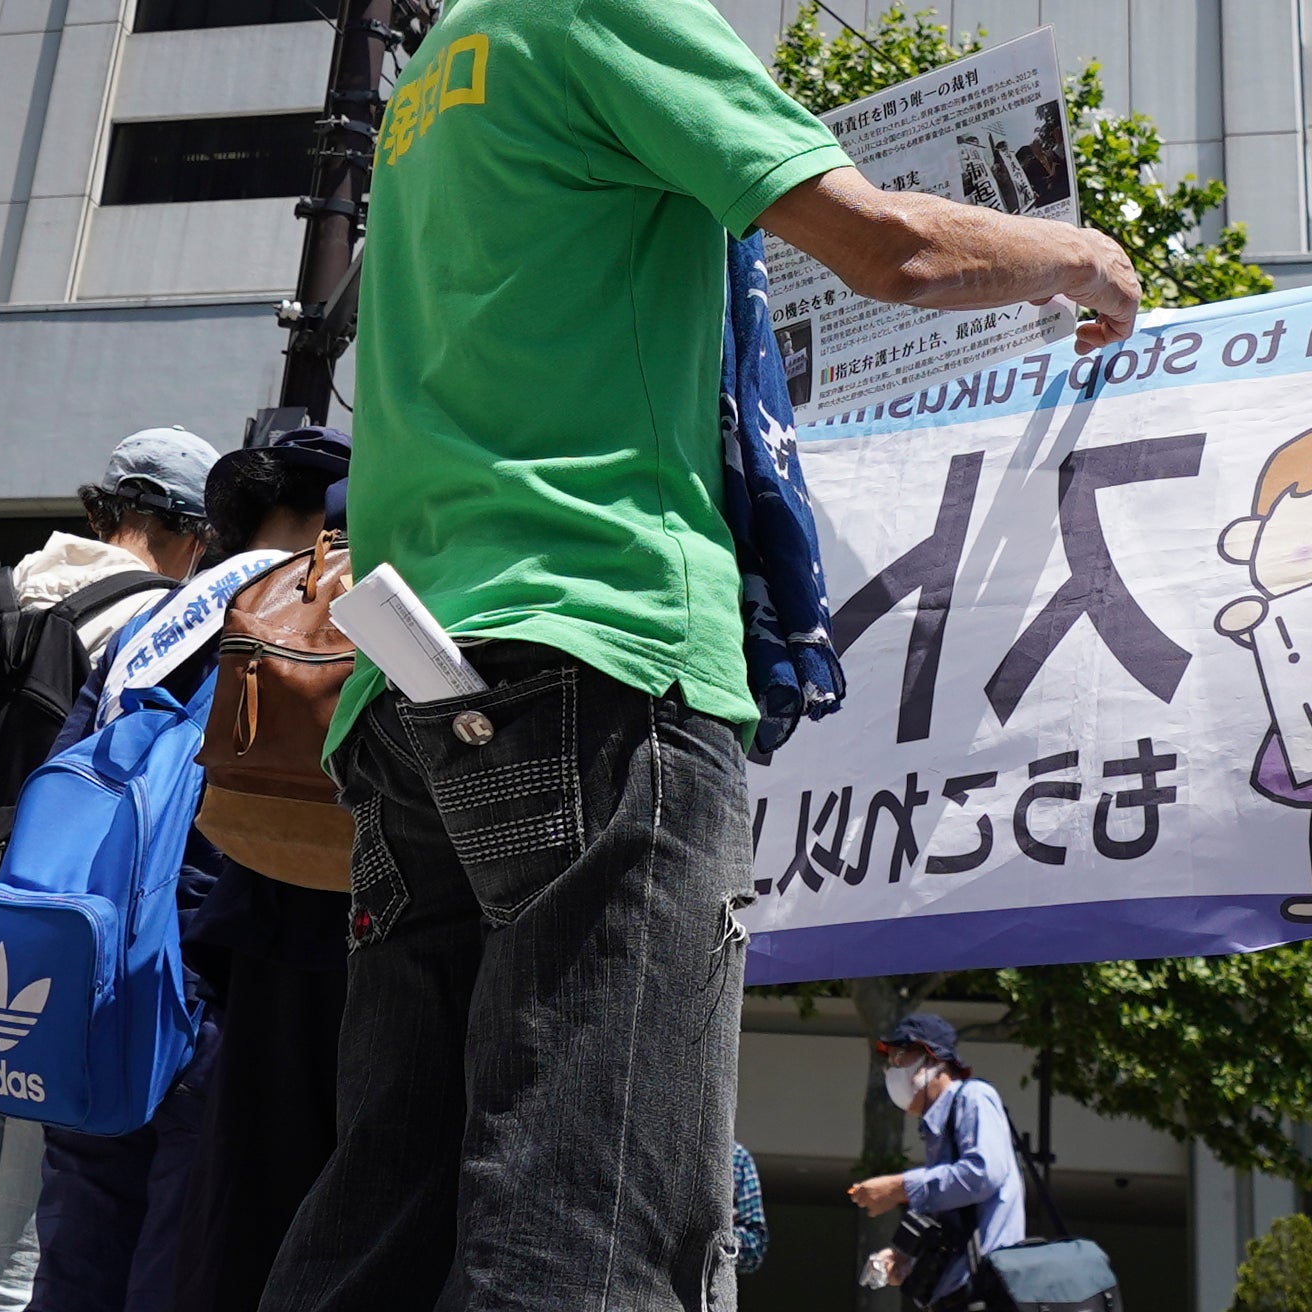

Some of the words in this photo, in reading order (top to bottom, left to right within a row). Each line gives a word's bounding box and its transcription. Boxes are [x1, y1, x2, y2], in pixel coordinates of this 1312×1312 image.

[373, 33, 489, 170] 発ゼロ
[827, 68, 979, 140] 事責任を問う唯一の裁判
